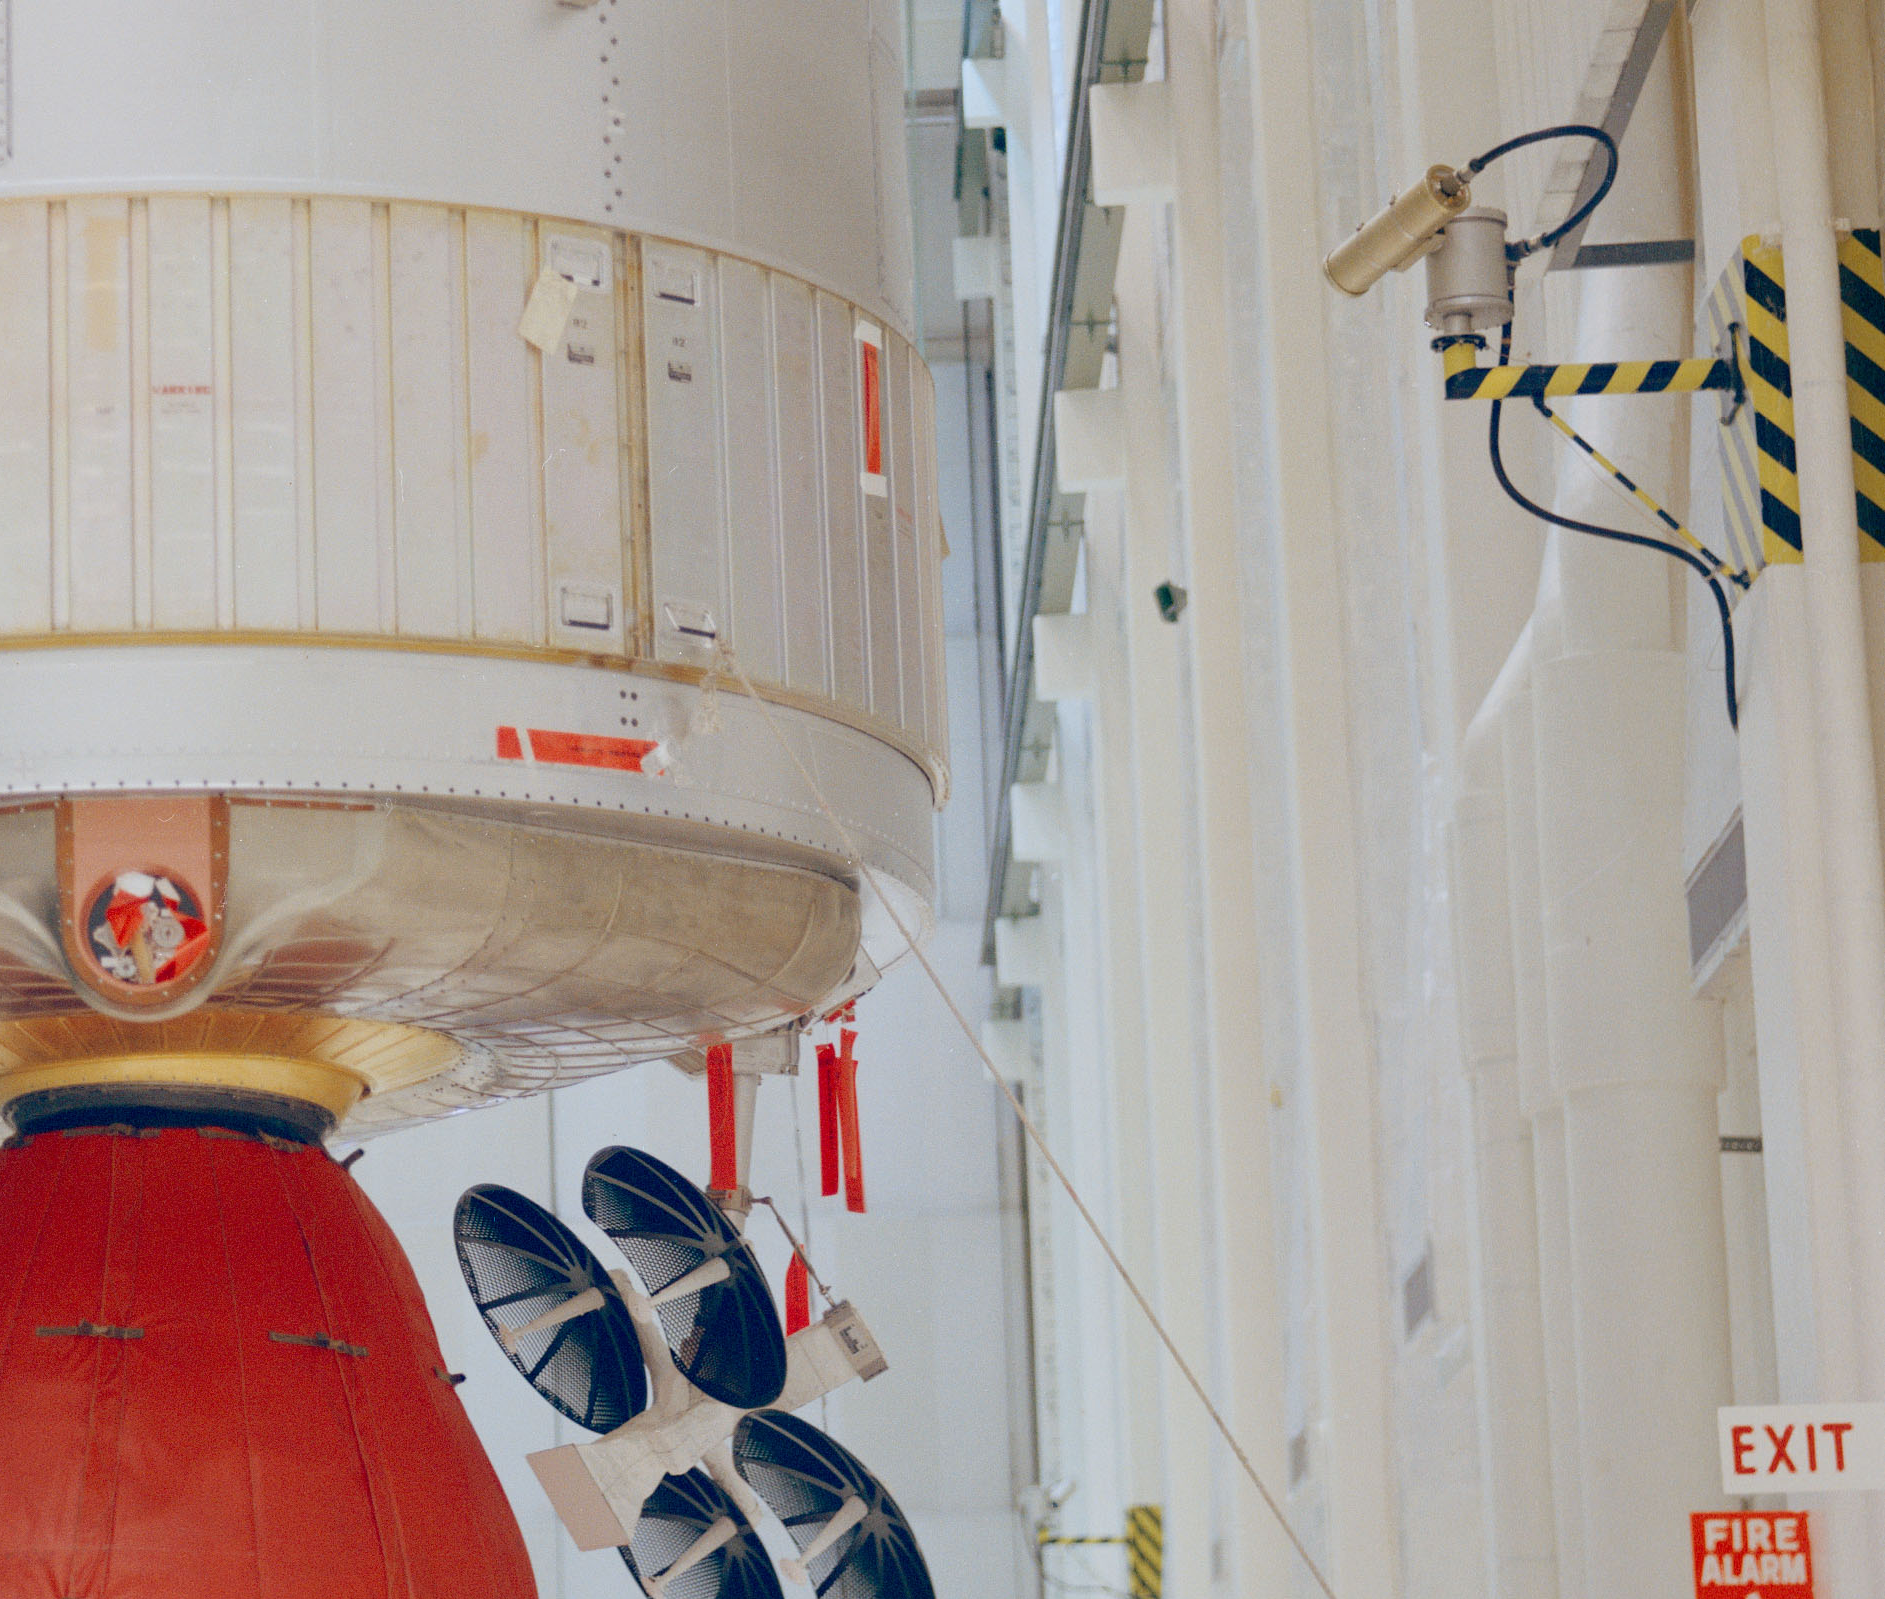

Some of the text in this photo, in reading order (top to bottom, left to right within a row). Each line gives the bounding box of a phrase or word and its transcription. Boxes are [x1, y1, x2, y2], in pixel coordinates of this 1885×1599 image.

[1731, 1423, 1853, 1475] EXIT
[1703, 1518, 1800, 1552] FIRE
[1701, 1553, 1807, 1586] ALARM
